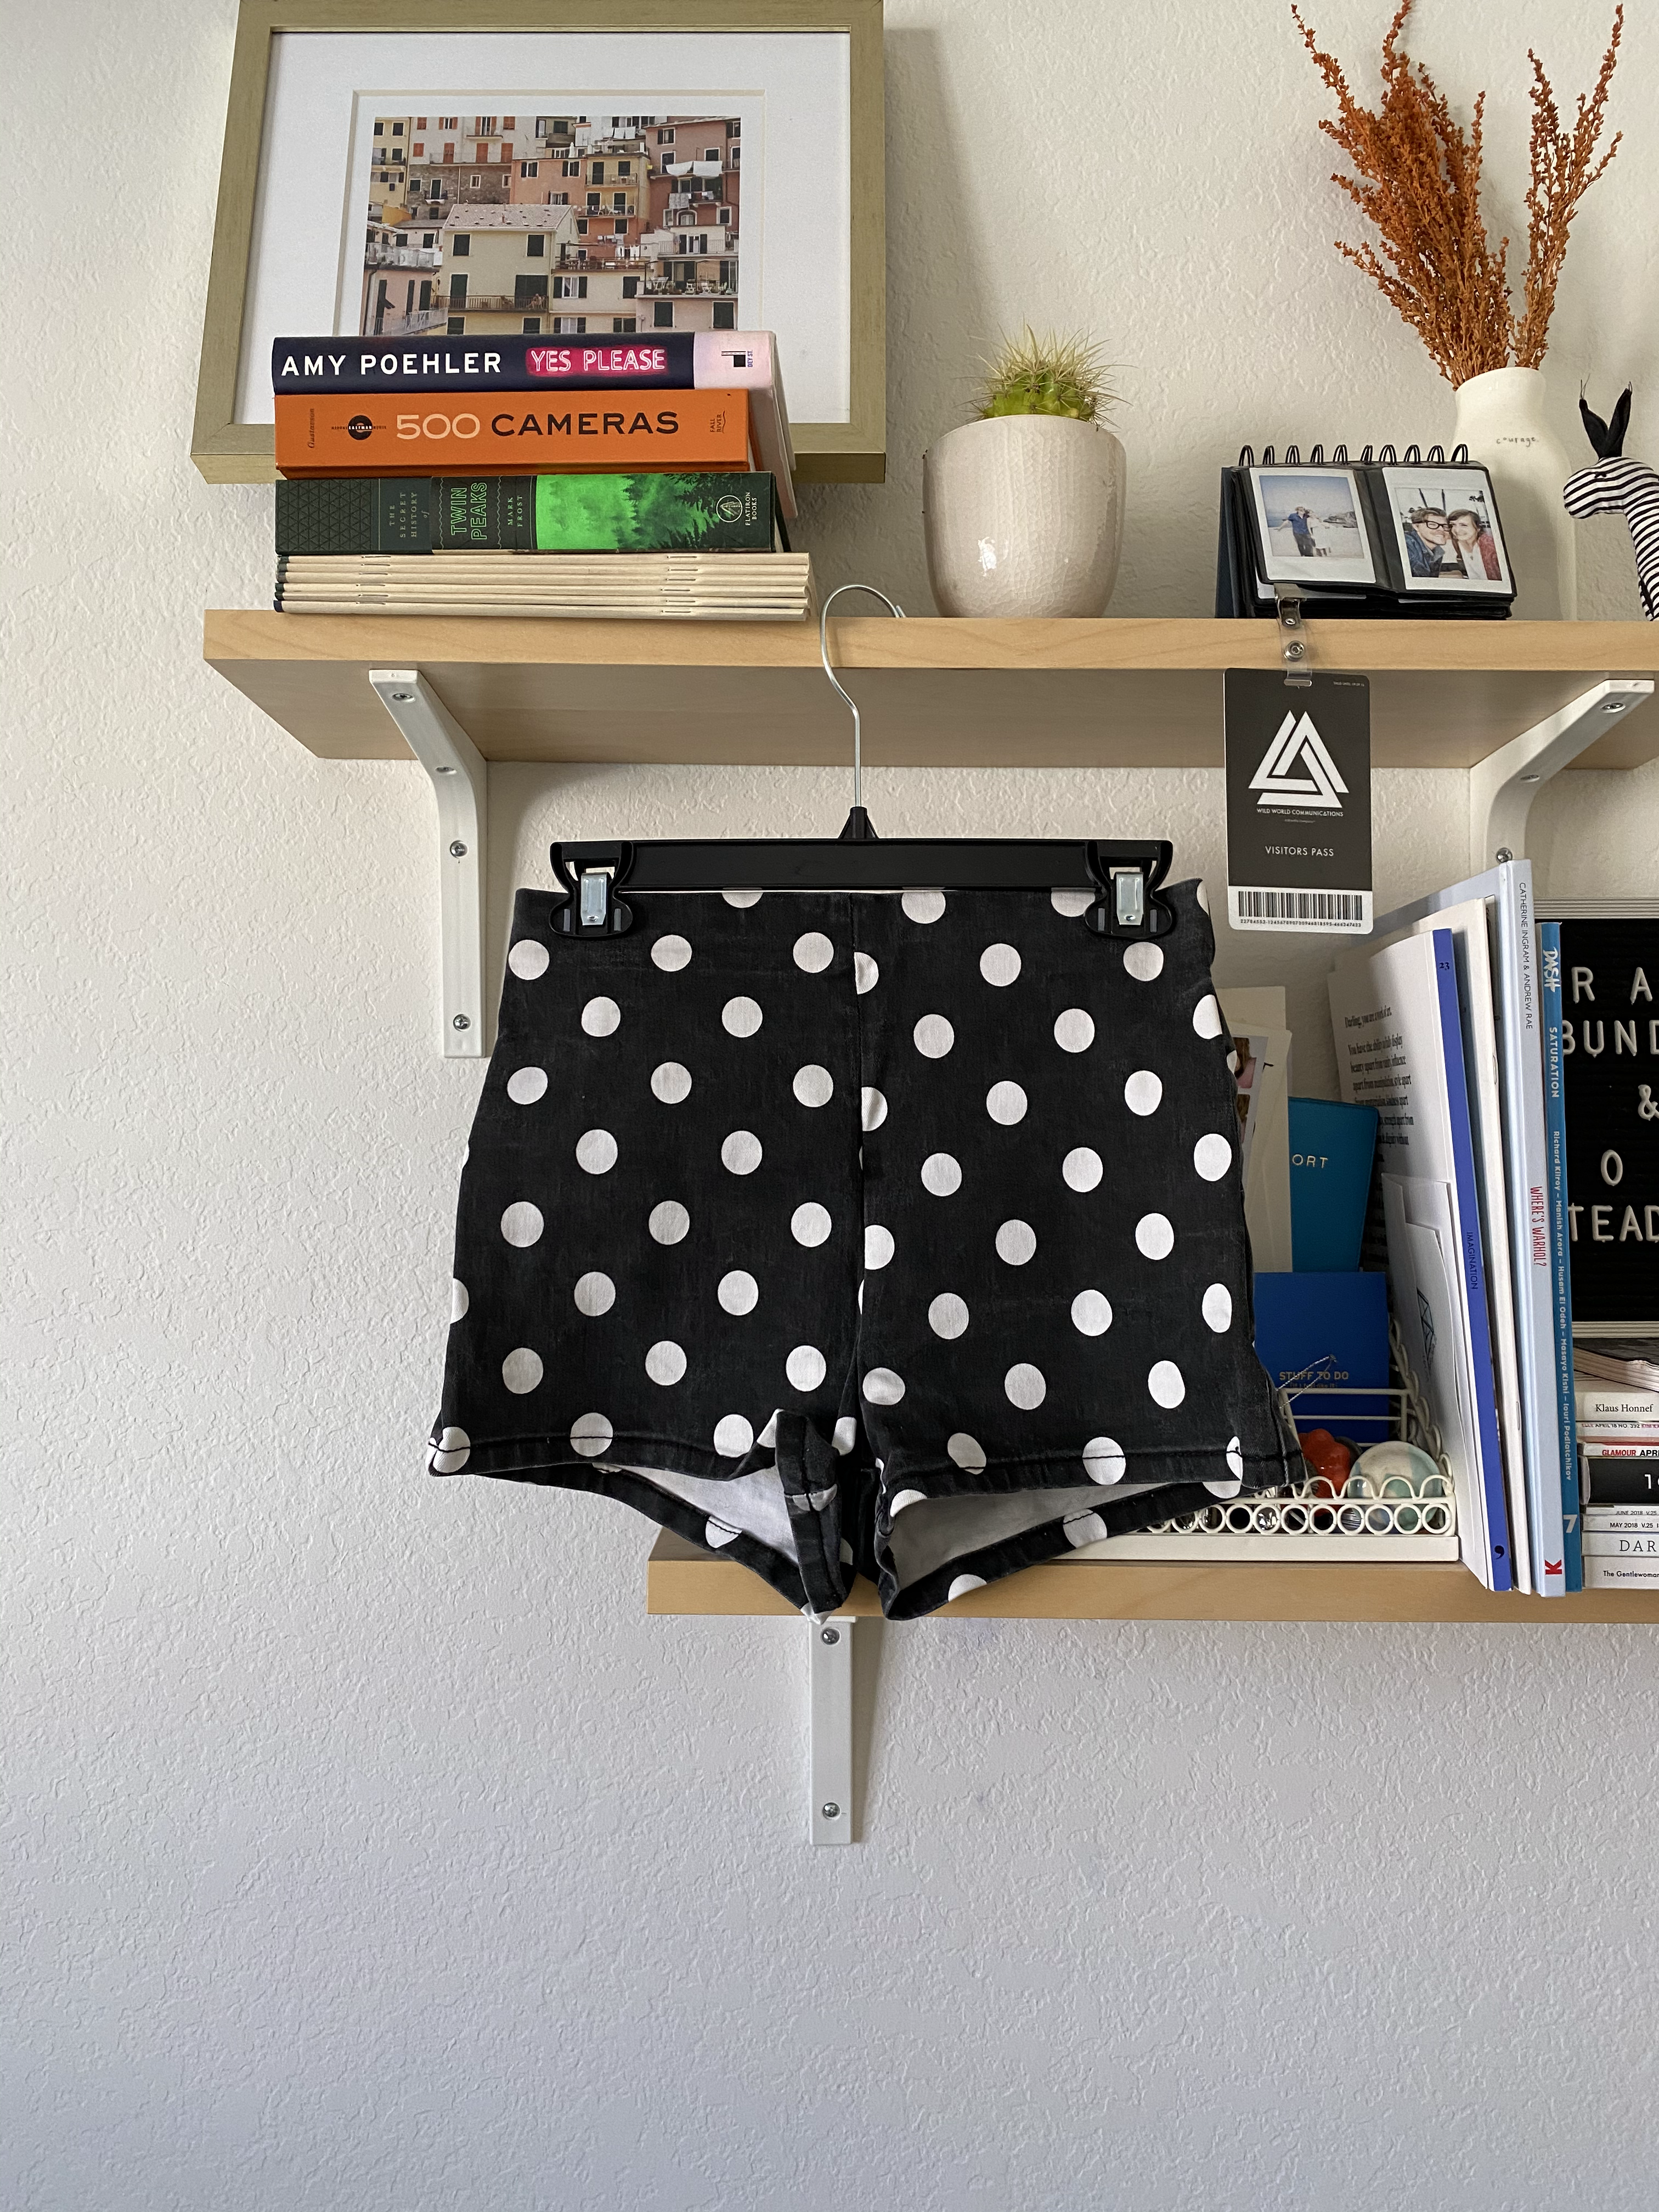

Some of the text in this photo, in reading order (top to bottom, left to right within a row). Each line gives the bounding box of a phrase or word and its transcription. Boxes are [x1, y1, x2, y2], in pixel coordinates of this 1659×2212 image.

[281, 352, 501, 376] AMY POEHLER
[530, 349, 665, 373] YES PLEASE
[396, 411, 679, 440] 500 CAMERAS
[421, 510, 430, 518] of
[450, 487, 467, 535] TWIN
[470, 482, 488, 540] PEAKS
[1265, 845, 1334, 857] VISITORS PASS
[1519, 882, 1528, 928] CATHERINE
[1521, 930, 1530, 962] INGRAM
[1438, 961, 1450, 971] 23
[1543, 946, 1561, 992] DASH
[1549, 1026, 1559, 1097] SATURATION
[1291, 1153, 1329, 1169] ORT
[1530, 1186, 1547, 1267] WHERE'S WARHOL?
[1466, 1232, 1479, 1290] IMAGINATION
[1279, 1371, 1349, 1380] STUFF TO DO
[1595, 1403, 1654, 1412] Klaus Honnef
[1644, 1474, 1659, 1489] 1
[1563, 1514, 1578, 1533] 7
[1620, 1539, 1657, 1552] DAR
